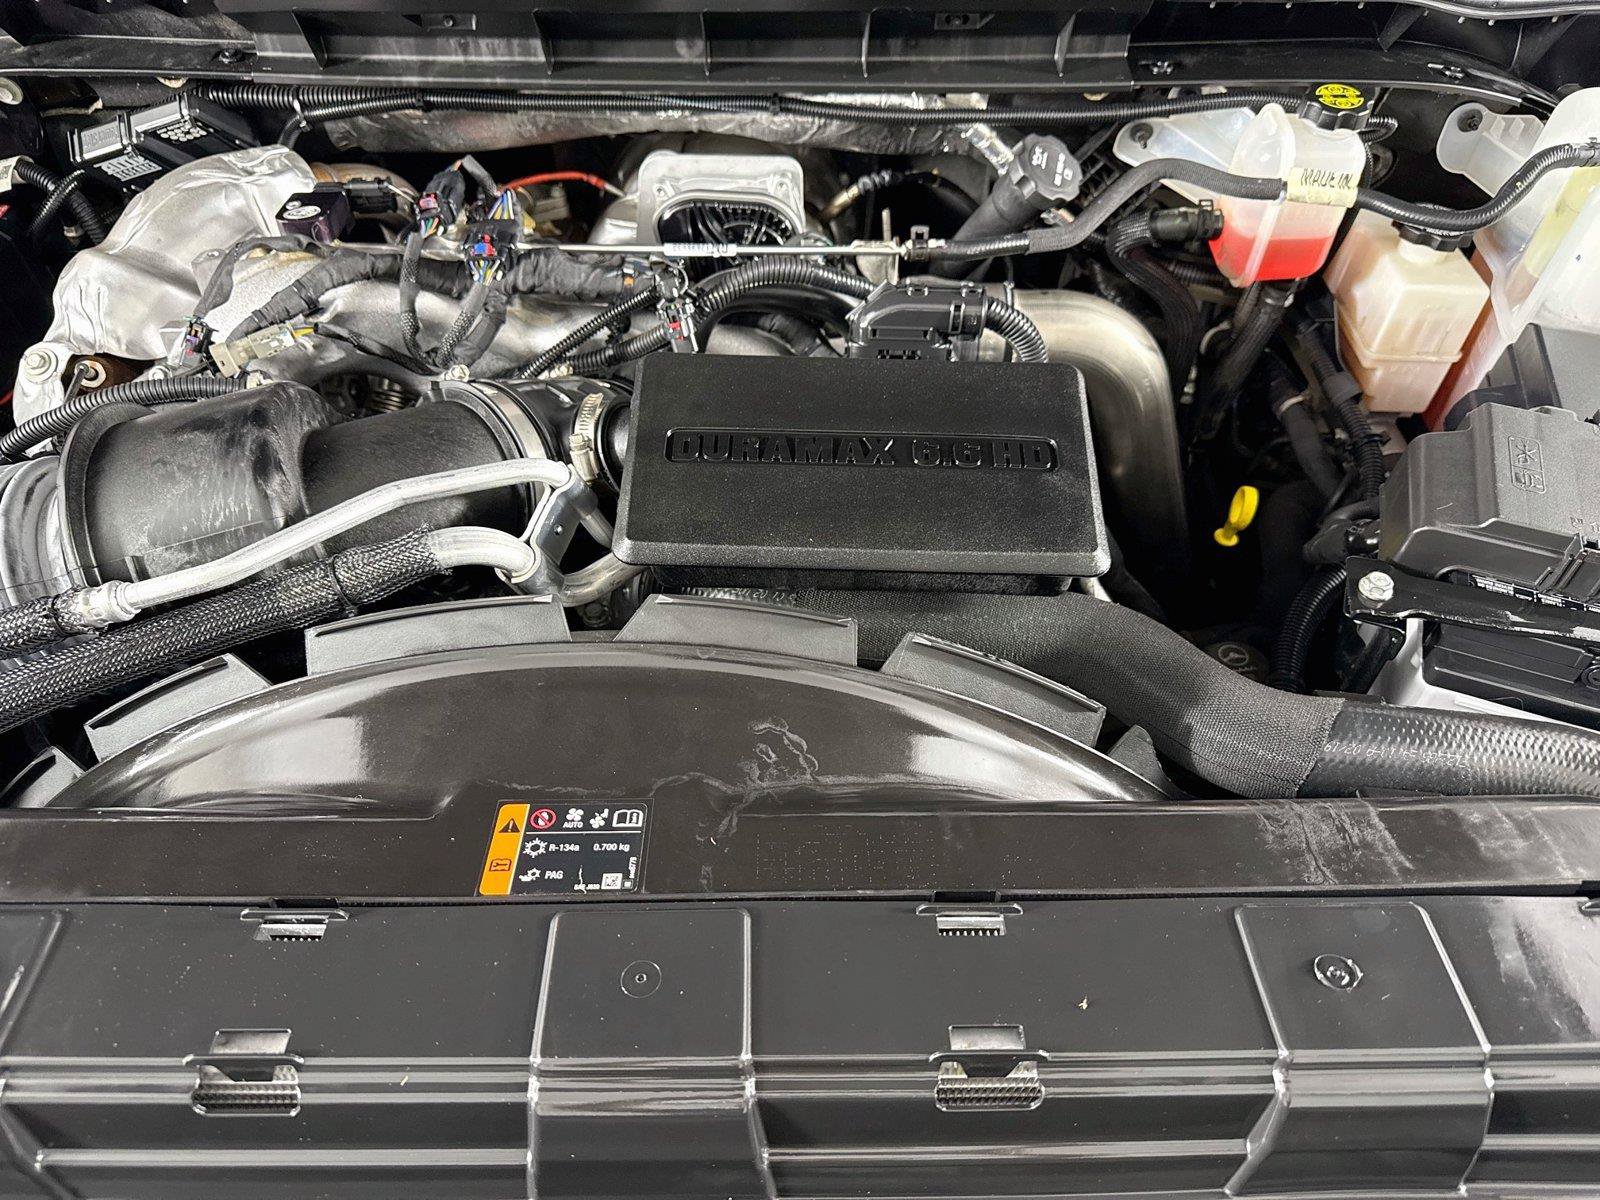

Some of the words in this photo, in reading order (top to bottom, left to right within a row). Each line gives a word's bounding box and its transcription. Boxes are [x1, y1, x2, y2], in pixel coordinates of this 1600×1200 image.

[672, 433, 895, 465] DURAMAX
[912, 438, 982, 467] 6.6
[992, 442, 1053, 470] HD
[562, 821, 584, 829] AUTO
[548, 843, 580, 852] R-134a
[593, 843, 617, 852] 0.700
[618, 842, 630, 853] kg
[544, 871, 563, 880] PAG
